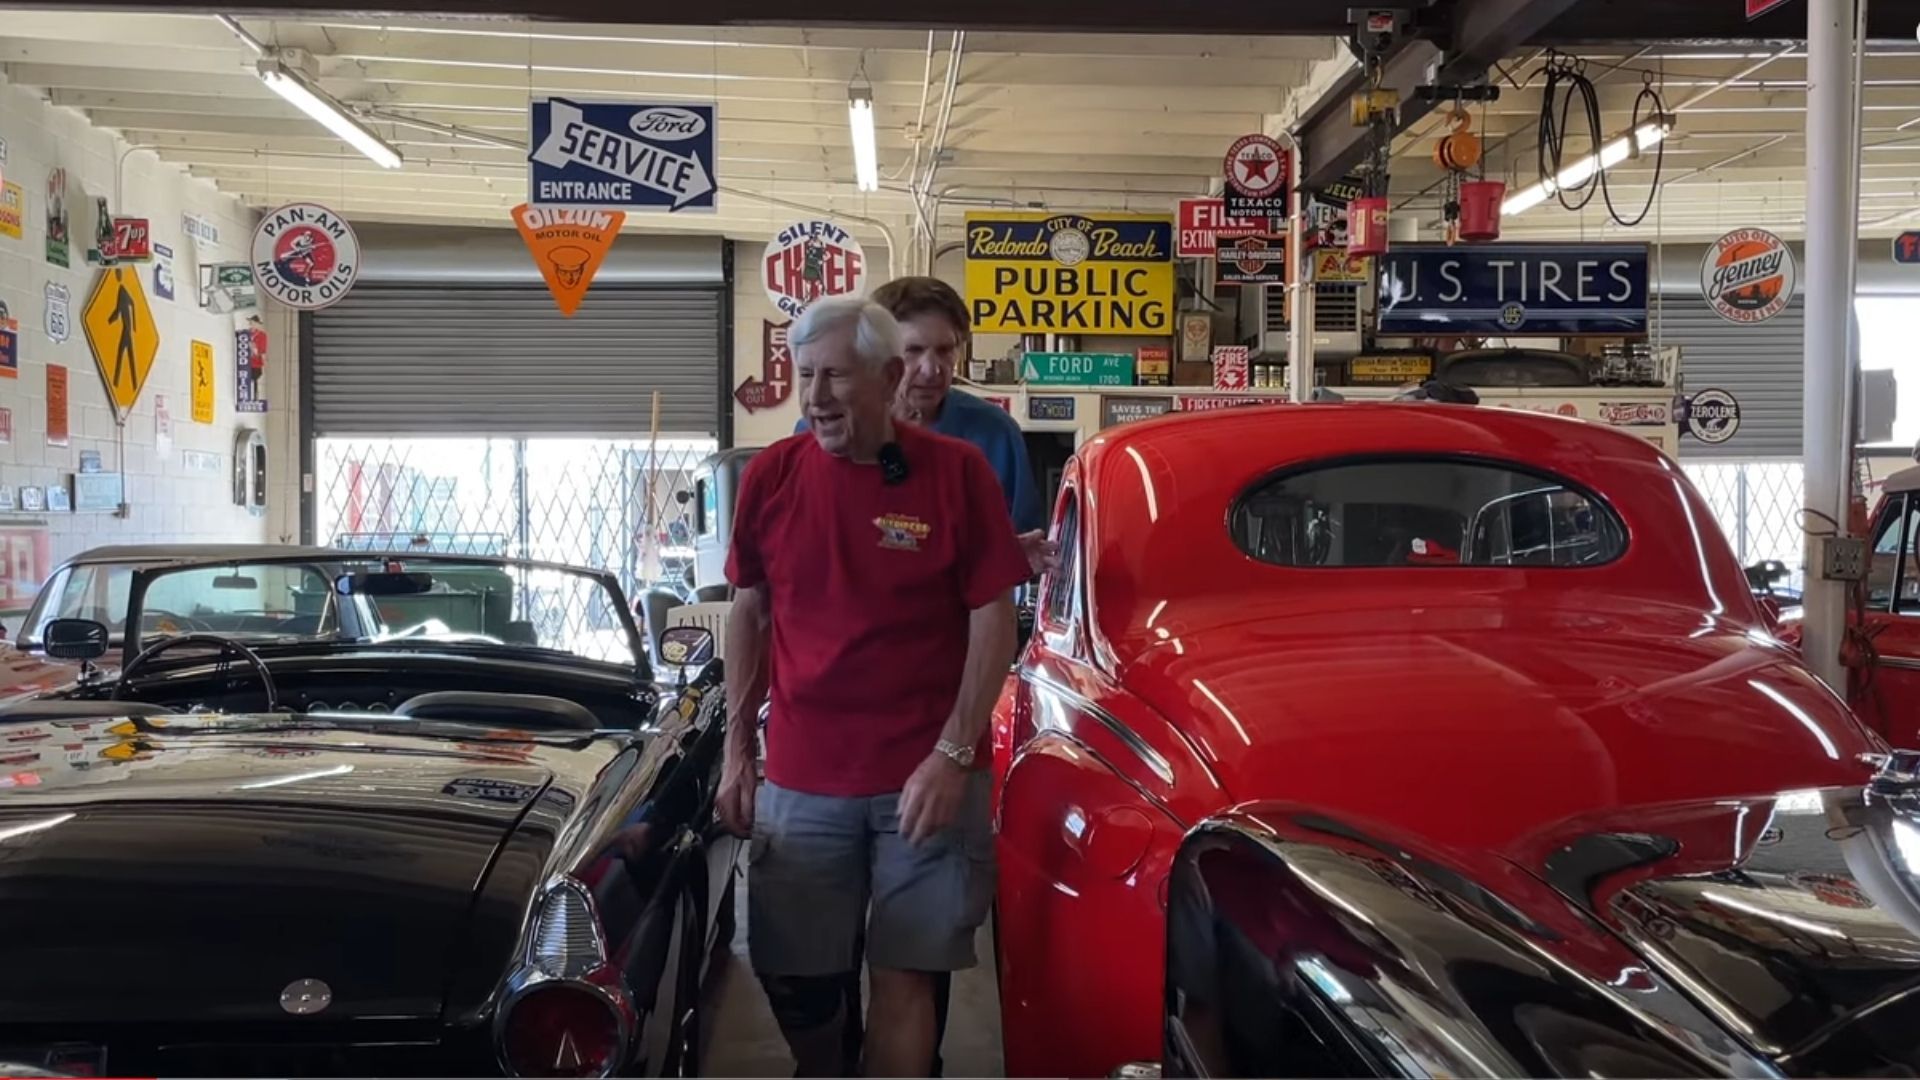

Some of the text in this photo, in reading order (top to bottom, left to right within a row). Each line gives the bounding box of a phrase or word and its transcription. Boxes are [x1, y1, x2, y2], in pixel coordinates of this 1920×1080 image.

[636, 111, 698, 134] Ford
[559, 121, 695, 194] SERVICE
[540, 181, 632, 200] ENTRANCE
[1230, 208, 1281, 217] MOTOR OIL
[1231, 198, 1282, 207] TEXACO
[264, 208, 346, 240] PAN-AM
[522, 208, 614, 231] OILZUM
[1047, 218, 1094, 234] CITY OF
[535, 229, 602, 242] MOTOR OIL
[778, 221, 849, 248] SILENT
[969, 226, 1048, 257] Redondo
[1716, 231, 1780, 252] AUTO OILS
[256, 261, 314, 303] MOTOR
[319, 263, 353, 299] OILS
[994, 267, 1149, 297] PUBLIC
[1487, 260, 1633, 303] TIRES
[973, 299, 1165, 329] PARKING
[1716, 297, 1785, 321] GASOLINE
[769, 328, 788, 399] EXIT
[1050, 357, 1120, 374] FORD AVE
[1218, 352, 1243, 365] FIRE
[1099, 375, 1120, 384] 1700
[1111, 404, 1163, 414] SAVES THE
[1691, 406, 1737, 418] ZEROLENE
